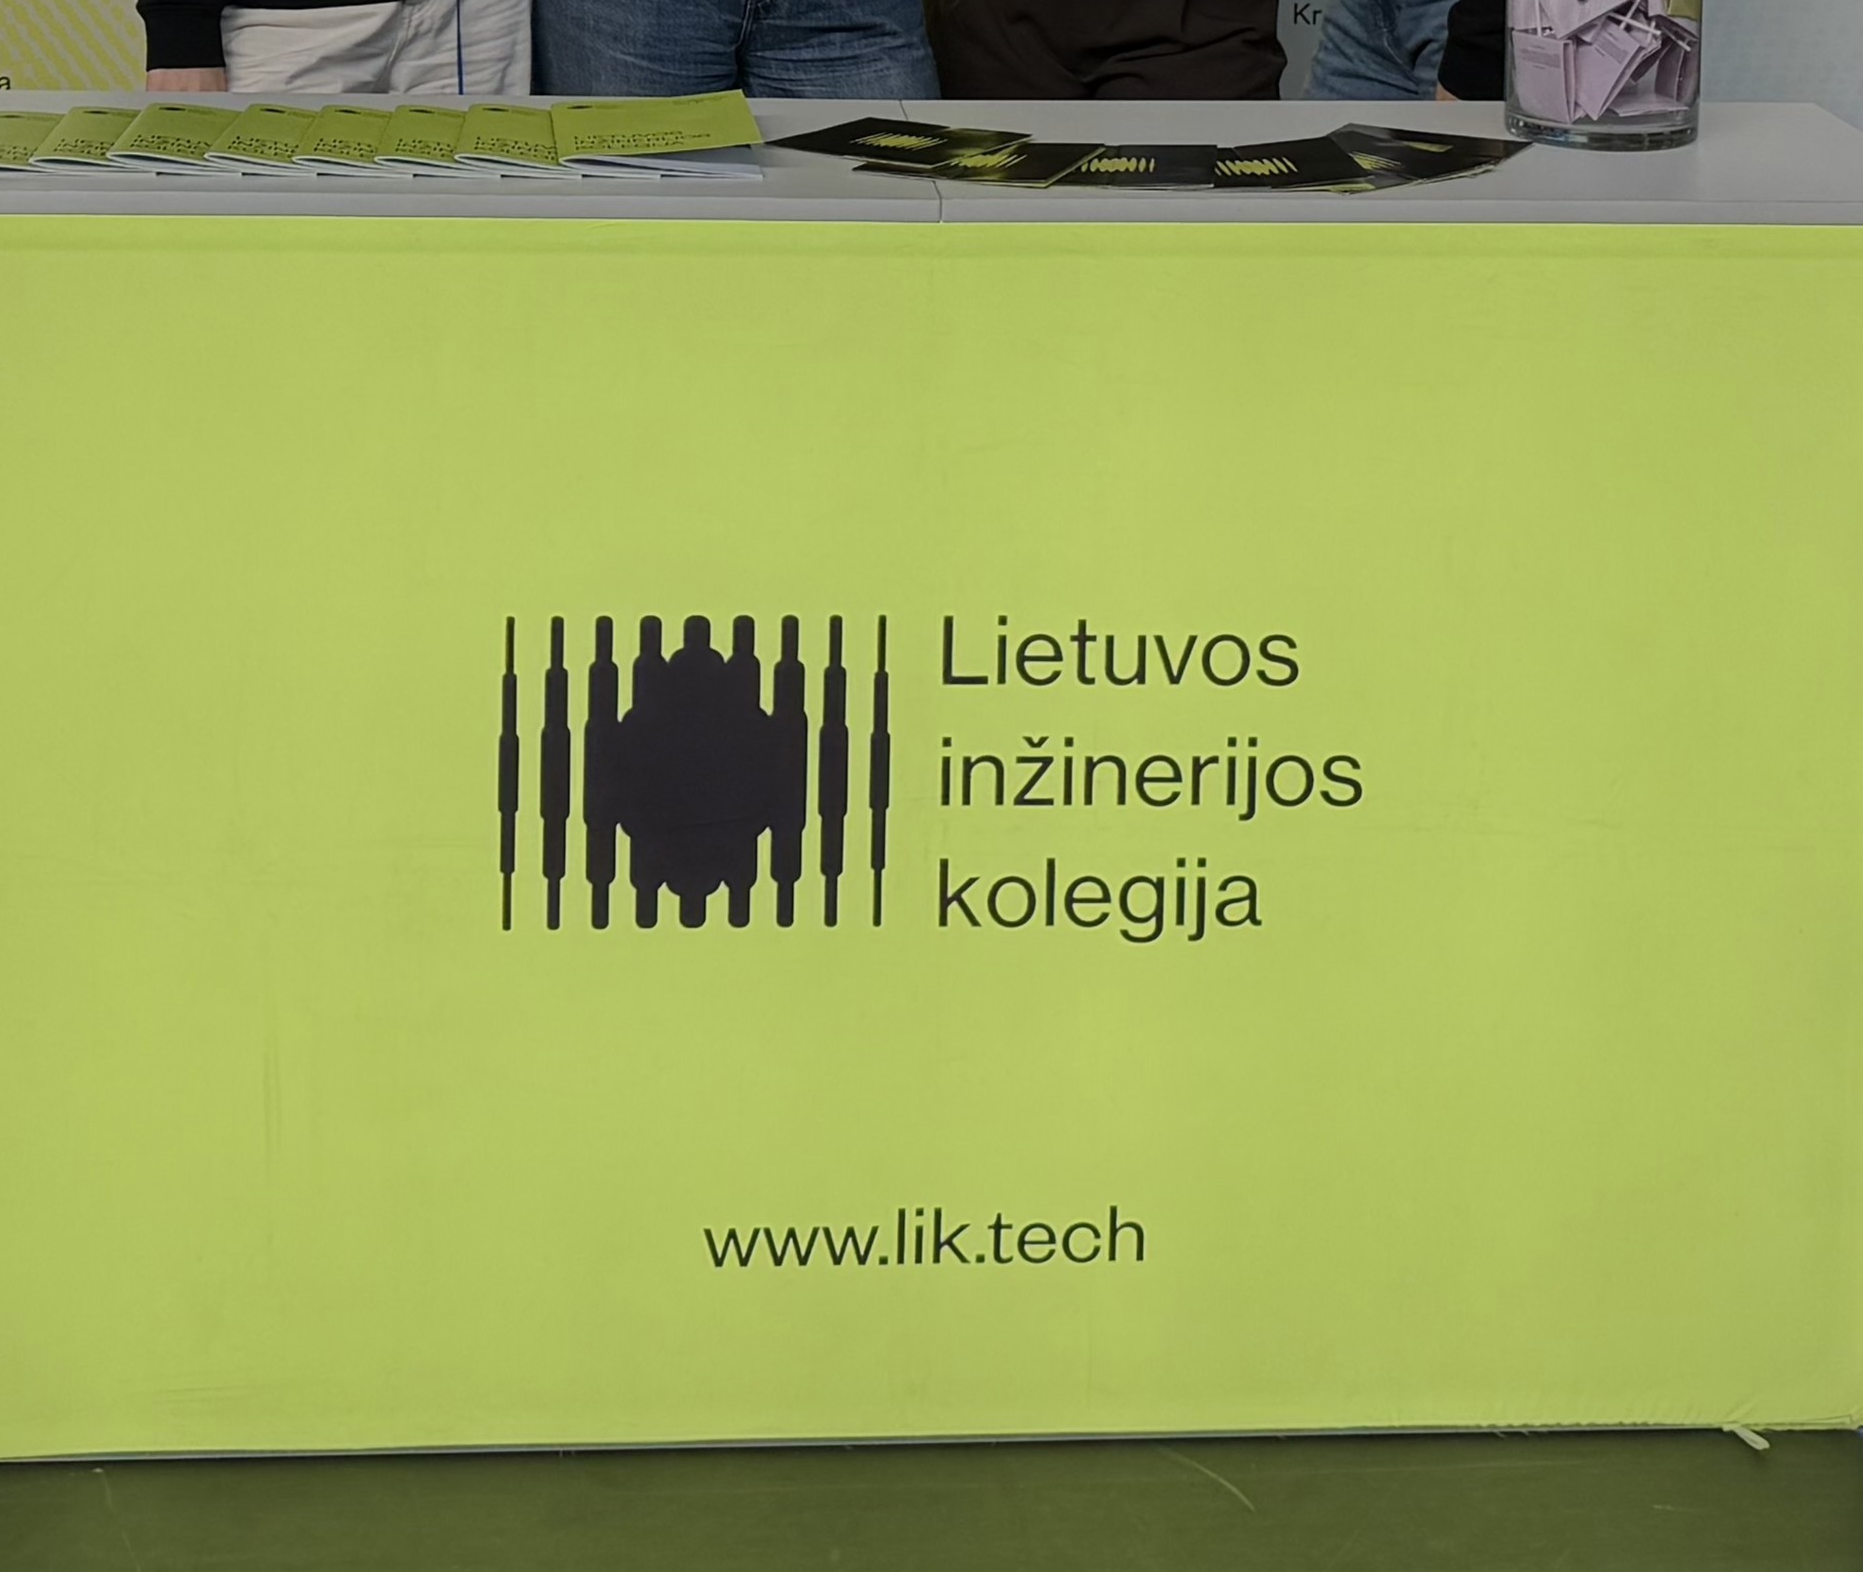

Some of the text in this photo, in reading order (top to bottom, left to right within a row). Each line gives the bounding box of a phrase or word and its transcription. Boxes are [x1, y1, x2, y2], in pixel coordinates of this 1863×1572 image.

[938, 613, 1301, 689] Lietuvos
[937, 736, 1365, 823] inžinerijos
[936, 857, 1263, 944] kolegija
[703, 1205, 1147, 1270] www.lik.tech
